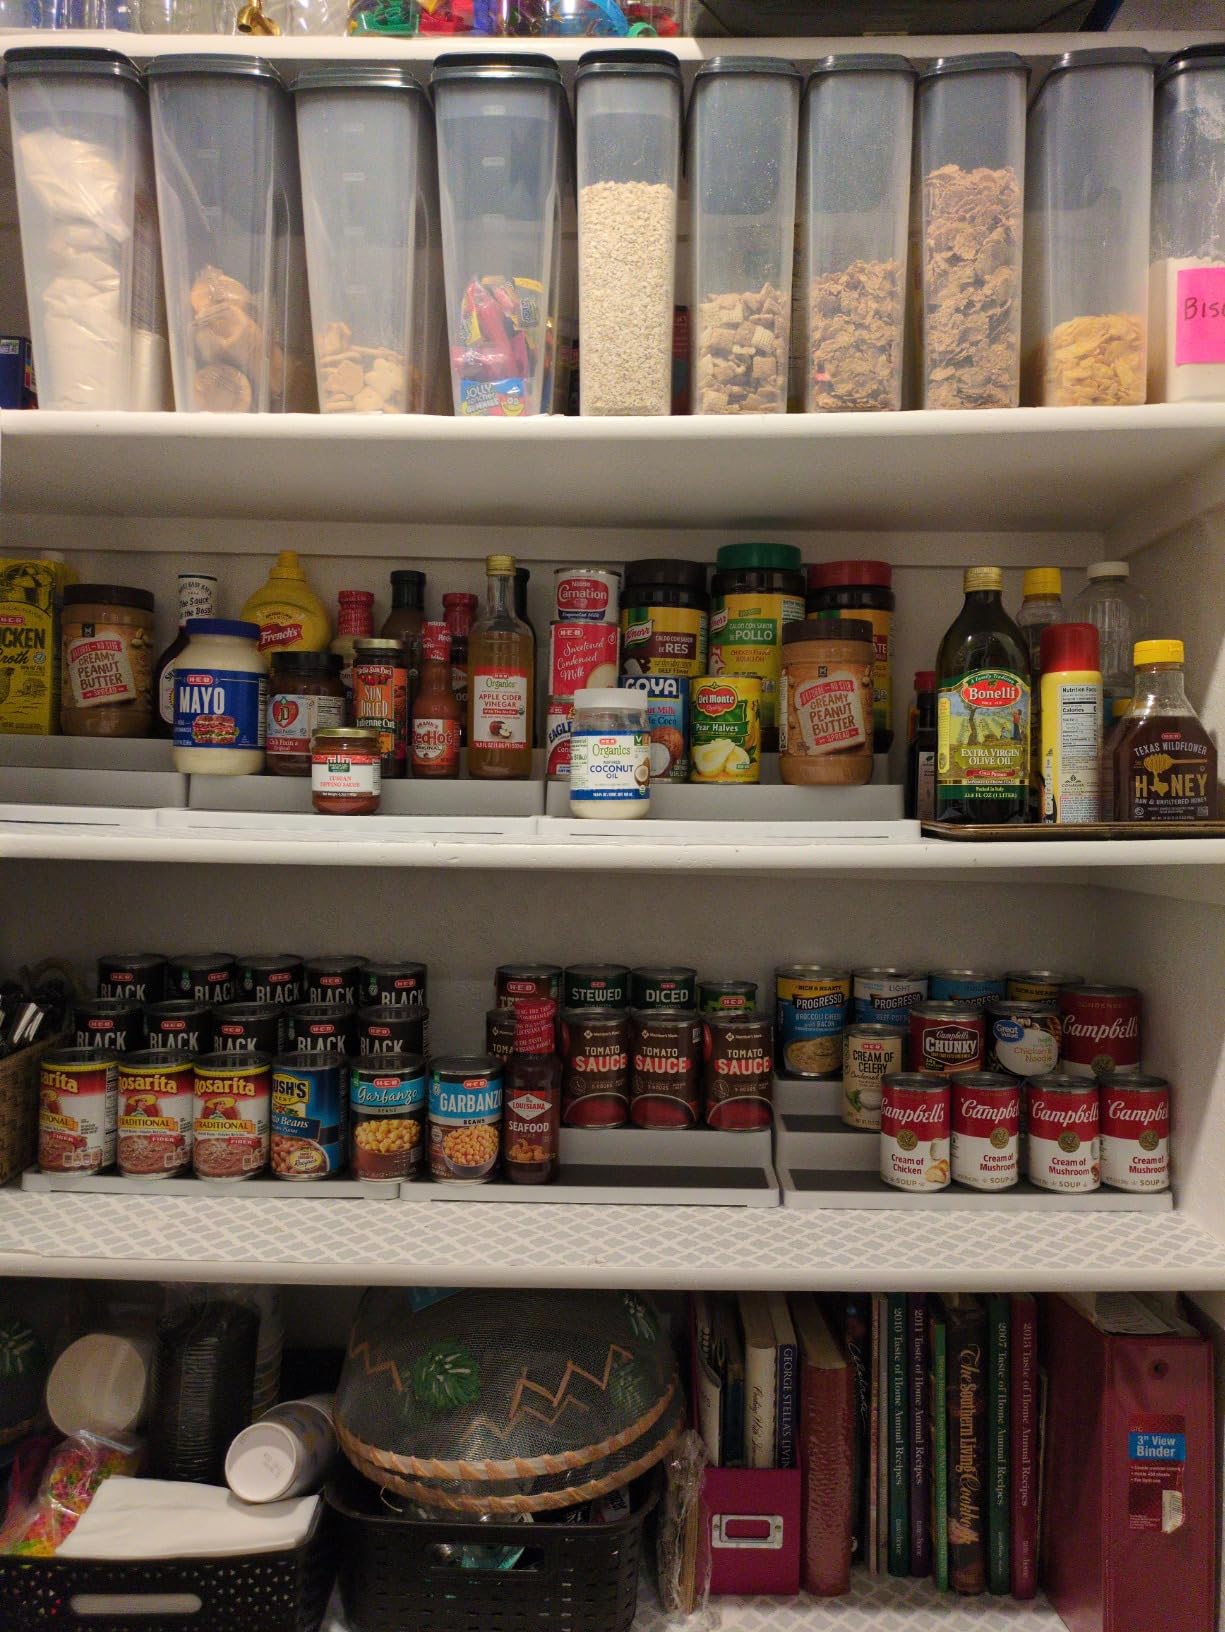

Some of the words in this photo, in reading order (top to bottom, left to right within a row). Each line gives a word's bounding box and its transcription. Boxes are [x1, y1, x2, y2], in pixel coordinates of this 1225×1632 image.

[466, 384, 492, 399] JOLLY
[190, 596, 209, 606] Sauce
[558, 584, 608, 602] Carnation
[2, 627, 46, 649] CKEN
[261, 627, 299, 644] French's
[735, 630, 772, 641] POLLO
[564, 638, 604, 656] Sweetened
[666, 643, 688, 654] RES
[78, 652, 116, 666] CREAMY
[557, 653, 598, 670] Condensed
[78, 660, 120, 679] PEANUT
[560, 667, 584, 680] Milk
[80, 672, 122, 690] BUTTER
[626, 679, 676, 694] GOYA
[180, 686, 225, 714] MAYO
[364, 687, 382, 702] SUN
[479, 694, 500, 702] APPLE
[502, 694, 522, 702] CIDER
[810, 692, 850, 710] CREAMY
[968, 687, 1016, 700] Bonelli
[362, 700, 388, 717] DRIED
[484, 700, 516, 708] VINEGAR
[810, 702, 852, 724] PEANUT
[696, 724, 708, 732] Pear
[712, 724, 738, 732] Halves
[812, 714, 856, 736] BUTTER
[592, 744, 630, 758] Organics
[961, 749, 988, 757] EXTRA
[990, 748, 1020, 756] VIRGIN
[1134, 742, 1160, 756] TEXAS
[1162, 742, 1208, 755] WILDFLOWER
[590, 764, 634, 773] COCONUT
[968, 757, 996, 765] OLIVE
[997, 756, 1013, 765] OIL
[100, 984, 146, 1000] BLACK
[256, 982, 300, 1004] BLACK
[310, 986, 354, 1004] BLACK
[572, 988, 622, 1002] STEWED
[646, 990, 689, 1002] DICED
[889, 984, 912, 992] LIGHT
[382, 988, 424, 1006] BLACK
[796, 994, 843, 1010] PROGRESSO
[874, 994, 921, 1010] PROGRESSO
[936, 1030, 968, 1040] Campbell's
[996, 1024, 1018, 1032] Great
[76, 1030, 127, 1050] BLACK
[150, 1032, 200, 1050] BLACK
[214, 1036, 256, 1052] BLACK
[298, 1034, 346, 1053] BLACK
[360, 1036, 404, 1056] BLACK
[925, 1036, 976, 1054] CHUNKY
[584, 1045, 620, 1056] TOMATO
[642, 1046, 678, 1057] TOMATO
[728, 1048, 764, 1058] TOMATO
[852, 1050, 882, 1063] CREAM
[884, 1052, 894, 1063] OF
[575, 1054, 628, 1072] SAUCE
[634, 1056, 687, 1074] SAUCE
[718, 1056, 770, 1076] SAUCE
[858, 1062, 888, 1074] CELERY
[358, 1086, 418, 1106] Garbanzo
[512, 1102, 546, 1110] LOUISIANA
[960, 1098, 1020, 1124] Campbel
[199, 1121, 249, 1130] RADITIONAL
[280, 1116, 310, 1129] Beans
[508, 1120, 550, 1133] SEAFOOD
[891, 1153, 915, 1165] Cream
[916, 1158, 924, 1166] of
[983, 1154, 1006, 1162] Cream
[1006, 1153, 1014, 1162] of
[1052, 1157, 1078, 1166] Cream
[1078, 1158, 1086, 1166] of
[1132, 1156, 1156, 1164] Cream
[1157, 1155, 1164, 1164] of
[893, 1164, 922, 1175] Chicken
[980, 1163, 1016, 1172] Mushroom
[1048, 1166, 1090, 1176] Mushroom
[896, 1178, 917, 1186] SOUP
[990, 1176, 1009, 1184] SOUP
[1059, 1180, 1081, 1188] SOUP
[894, 1308, 903, 1332] 2010
[914, 1310, 924, 1332] 2011
[997, 1322, 1008, 1350] 2007
[894, 1335, 904, 1361] Taste
[914, 1336, 924, 1361] Taste
[783, 1348, 793, 1392] GEORGE
[894, 1364, 904, 1375] of
[914, 1364, 924, 1374] of
[960, 1344, 981, 1383] The
[998, 1351, 1008, 1377] Taste
[1022, 1350, 1032, 1378] Taste
[895, 1377, 904, 1405] Home
[915, 1376, 924, 1404] Home
[998, 1380, 1007, 1392] of
[1023, 1380, 1032, 1392] of
[782, 1394, 793, 1437] STELLA'S
[960, 1384, 977, 1437] Southern
[998, 1394, 1007, 1424] Home
[1022, 1394, 1032, 1424] Home
[895, 1409, 904, 1444] Annual
[915, 1408, 925, 1444] Annual
[998, 1427, 1007, 1463] Annual
[1022, 1426, 1032, 1464] Annual
[1136, 1436, 1149, 1445] 3"
[1152, 1436, 1176, 1446] View
[781, 1440, 793, 1468] LIVIN
[955, 1438, 977, 1472] Living
[1136, 1446, 1176, 1457] Binder
[893, 1446, 904, 1486] Recipes
[914, 1446, 924, 1485] Recipes
[996, 1466, 1007, 1505] Recipes
[1020, 1466, 1032, 1506] Recipes
